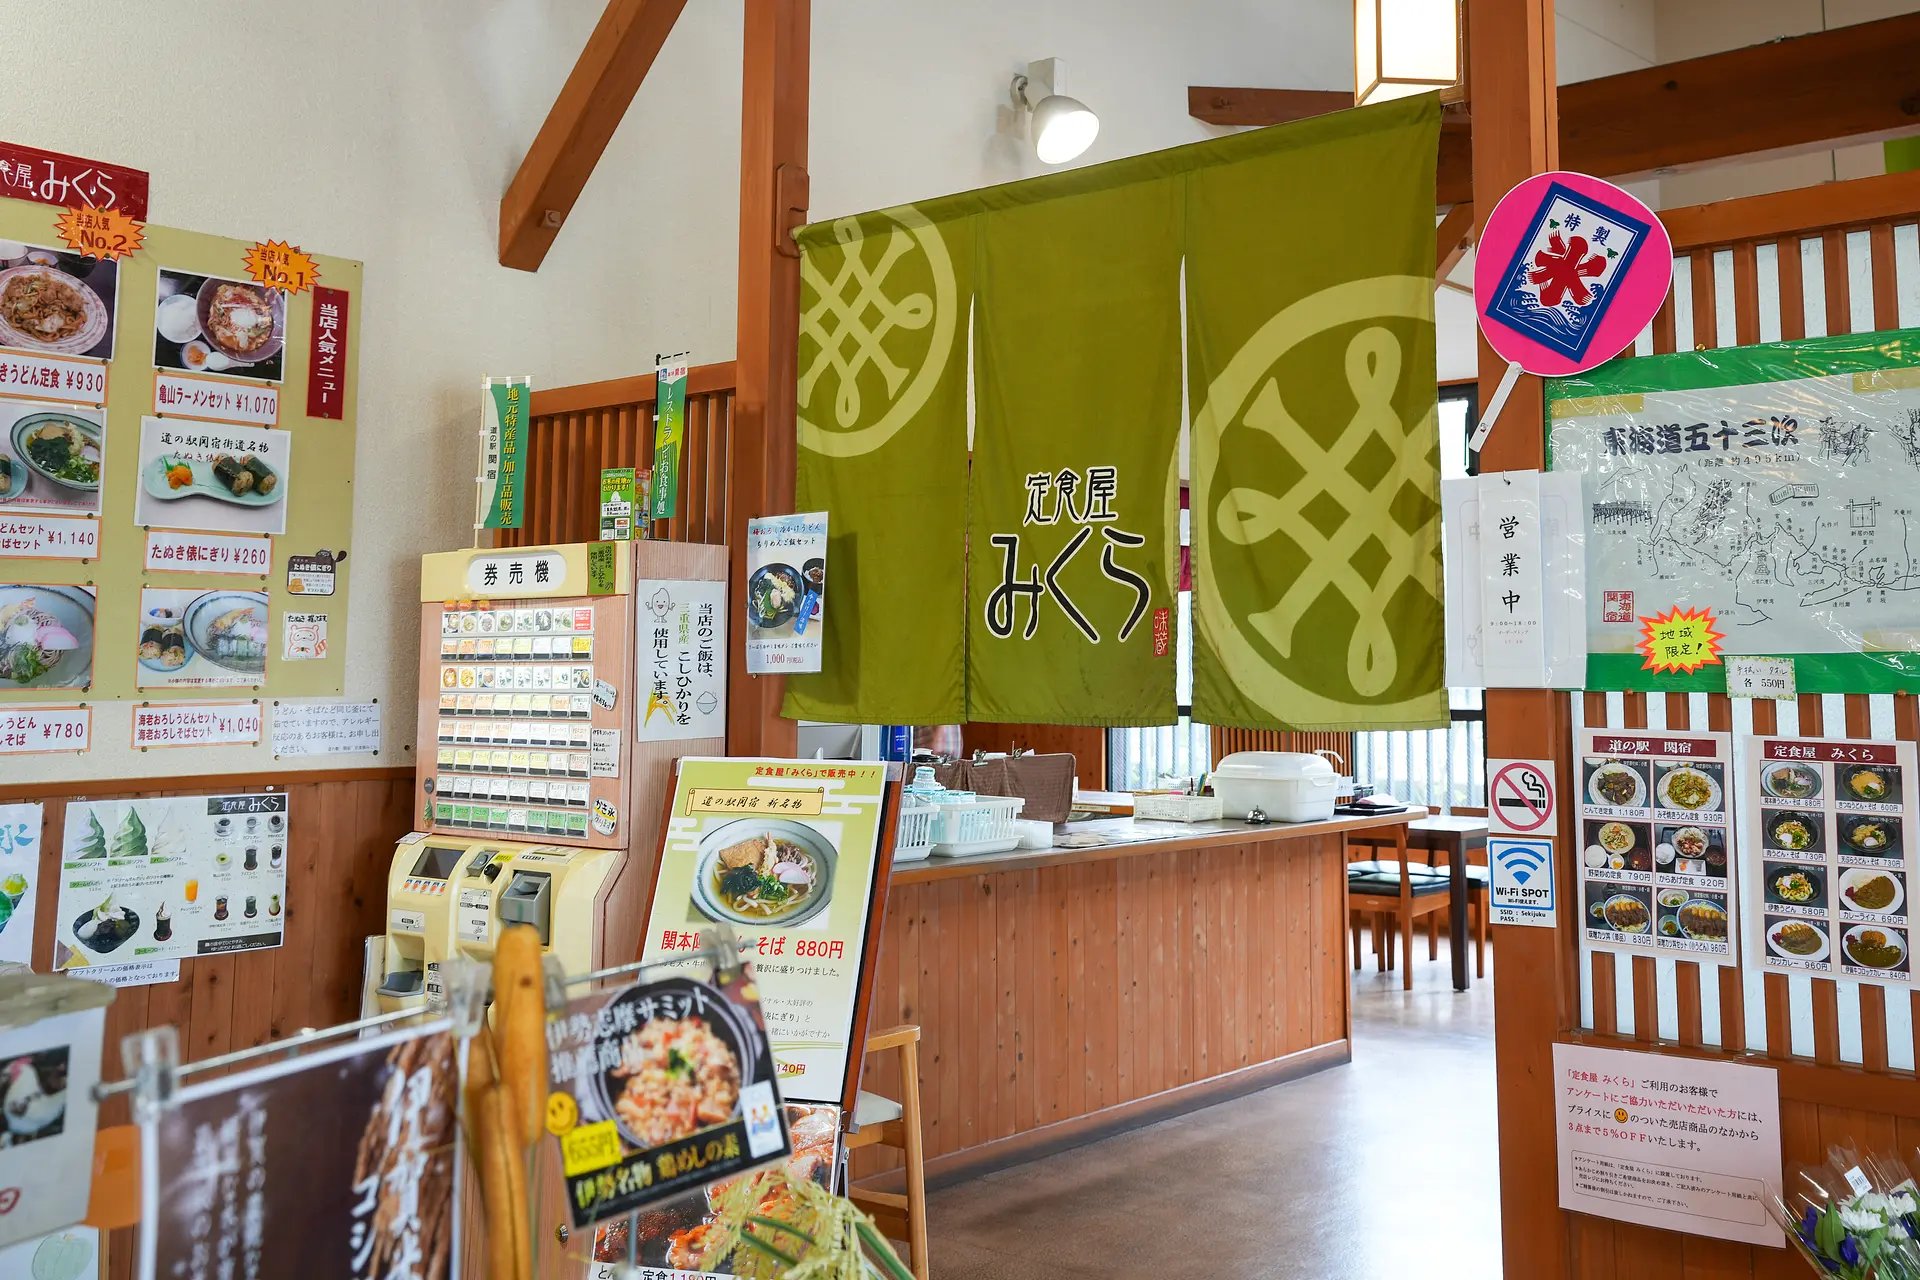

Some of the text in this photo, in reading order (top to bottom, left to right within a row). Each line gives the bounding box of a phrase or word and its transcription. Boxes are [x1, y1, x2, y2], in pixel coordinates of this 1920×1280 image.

[40, 159, 117, 210] みくら
[76, 213, 110, 231] 当店人気
[1564, 212, 1611, 247] 特製
[80, 229, 127, 252] No.2
[260, 248, 290, 266] 当店人気
[263, 264, 304, 287] No.1
[1528, 229, 1608, 308] 氷
[317, 303, 339, 404] 当店人気メニュー
[159, 383, 232, 411] 亀山ラーメンセット
[1602, 414, 1799, 457] 東海道五十三次
[487, 426, 498, 480] 道の駅 関宿
[500, 387, 519, 525] 地元特産品・加工品販売
[656, 387, 674, 515] レストラン・お食事処
[1024, 466, 1118, 526] 定食屋
[0, 538, 41, 550] ばセット
[151, 544, 230, 563] たぬき俵にぎり
[1499, 515, 1521, 614] 営業中
[484, 560, 550, 586] 券売機
[984, 526, 1151, 644] みくら
[697, 602, 713, 678] 当店のご飯は、
[1660, 625, 1696, 641] 地域
[675, 602, 692, 726] 三重県産 こしひかりを
[765, 653, 785, 664] 1,000
[653, 628, 669, 706] 使用しています。
[1744, 677, 1785, 689] 各 550円
[0, 717, 36, 730] うどん
[138, 711, 217, 727] 海老おろしうどんセット
[0, 733, 27, 746] そば
[138, 726, 213, 741] 海老おろしそばセット
[1608, 738, 1692, 753] 道の駅 関宿
[1774, 746, 1874, 761] 定食屋 みくら
[755, 766, 876, 778] 定食屋「みくら」で販売中！！
[248, 796, 279, 812] みくら
[766, 798, 803, 809] 新名物
[1804, 799, 1821, 807] 880円
[1584, 807, 1614, 816] とんてき定食
[1703, 813, 1723, 823] 930円
[1805, 851, 1824, 861] 730円
[1883, 858, 1901, 867] 730円
[1628, 872, 1651, 882] 790円
[1659, 875, 1725, 888] からあげ定食 920円
[1495, 886, 1549, 898] Wi-Fi SPOT
[1768, 904, 1825, 916] 伊勢うどん 580円
[1843, 911, 1904, 924] カレーライス 690円
[1632, 935, 1652, 945] 830円
[1710, 942, 1727, 953] 960円
[795, 939, 845, 960] 880円
[1770, 957, 1828, 971] カツカレー 960円
[1889, 970, 1907, 980] 840円
[1641, 1079, 1719, 1099] ご利用のお客様で
[1630, 1114, 1760, 1141] のついた売店商品のなかから
